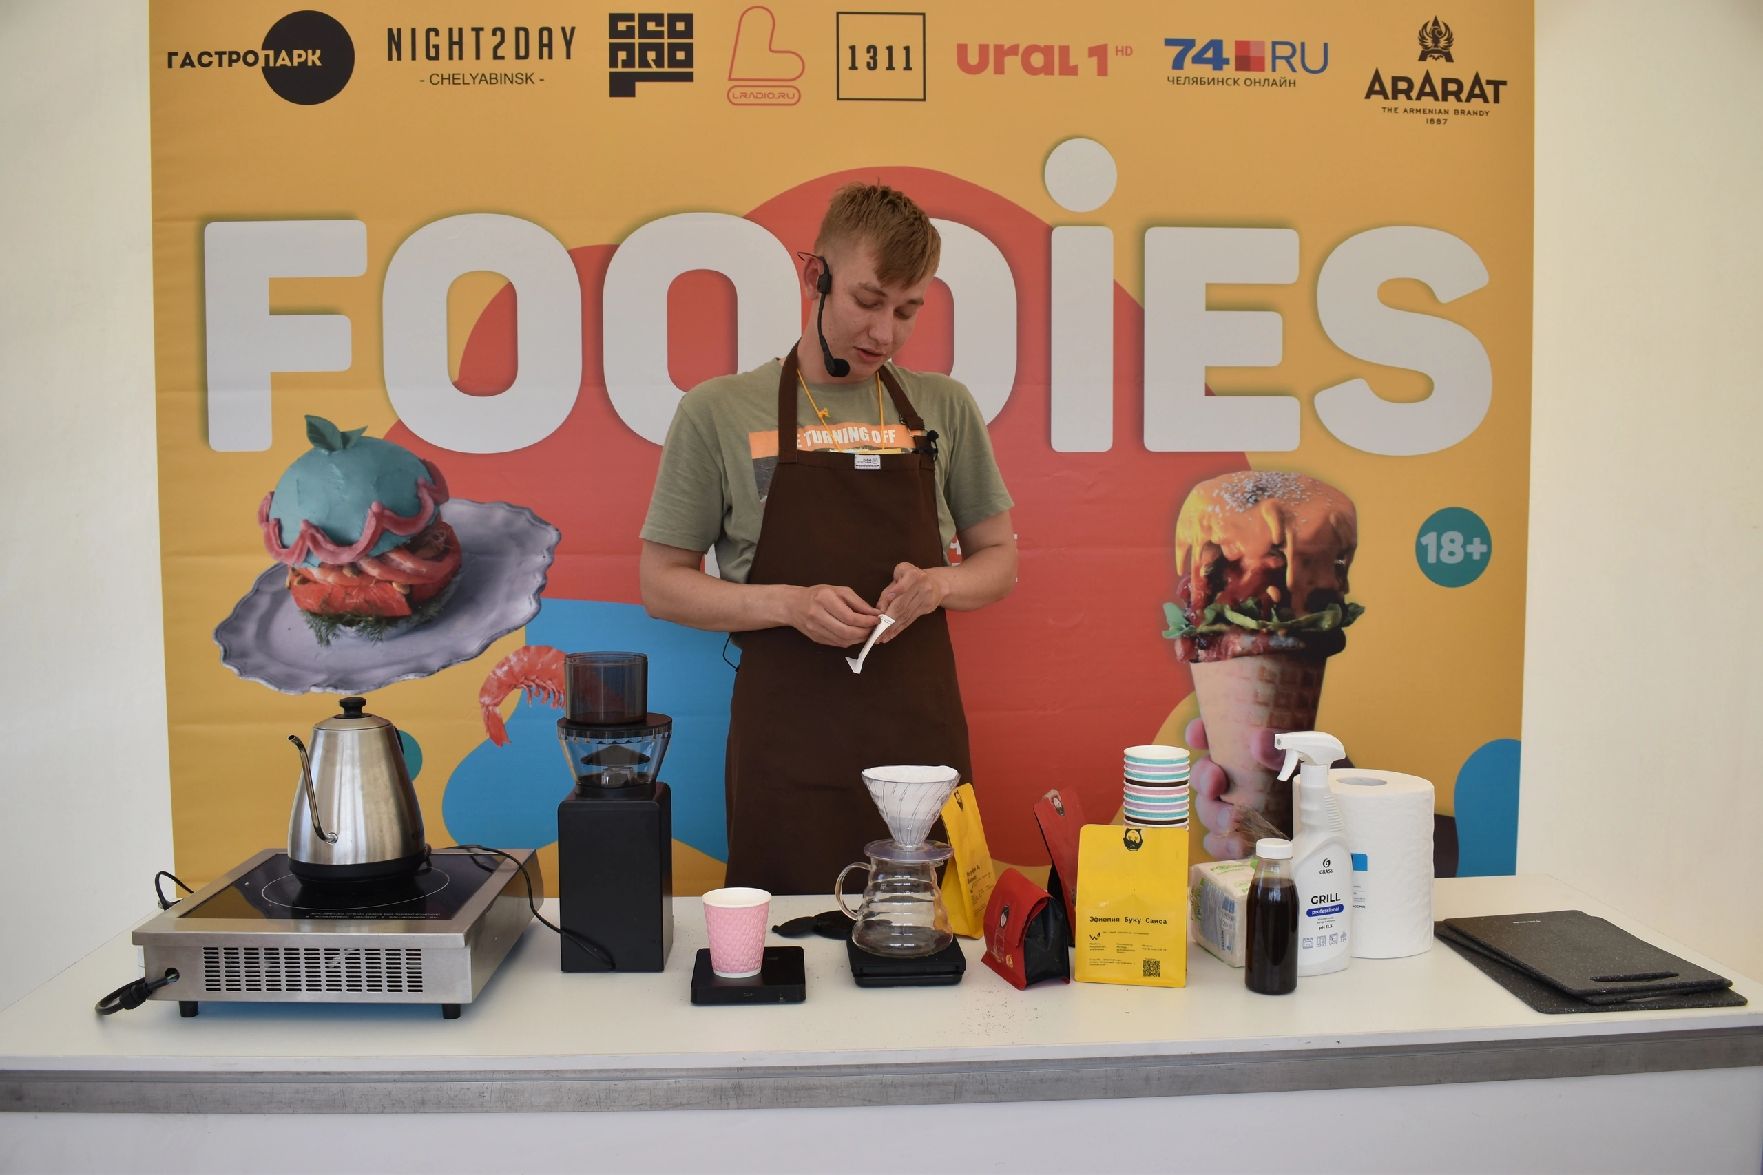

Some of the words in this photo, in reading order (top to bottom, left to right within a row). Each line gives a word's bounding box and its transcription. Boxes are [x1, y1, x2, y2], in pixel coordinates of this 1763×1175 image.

[387, 26, 576, 61] NIGHT2DAY
[1115, 46, 1134, 58] HD
[167, 49, 322, 69] ГАСТРОПАРК
[848, 45, 913, 71] 1311
[1167, 76, 1240, 87] ЧЕЛЯБИНСК
[1243, 76, 1297, 88] ОНЛАЙН
[1364, 67, 1508, 104] ARARAT
[732, 91, 796, 100] LRADIO.RU
[1381, 106, 1399, 114] THE
[1453, 109, 1490, 117] BRANDY
[804, 426, 869, 448] TURNING
[871, 429, 896, 445] OFF
[1420, 530, 1489, 565] 18+
[1310, 892, 1341, 905] GRILL
